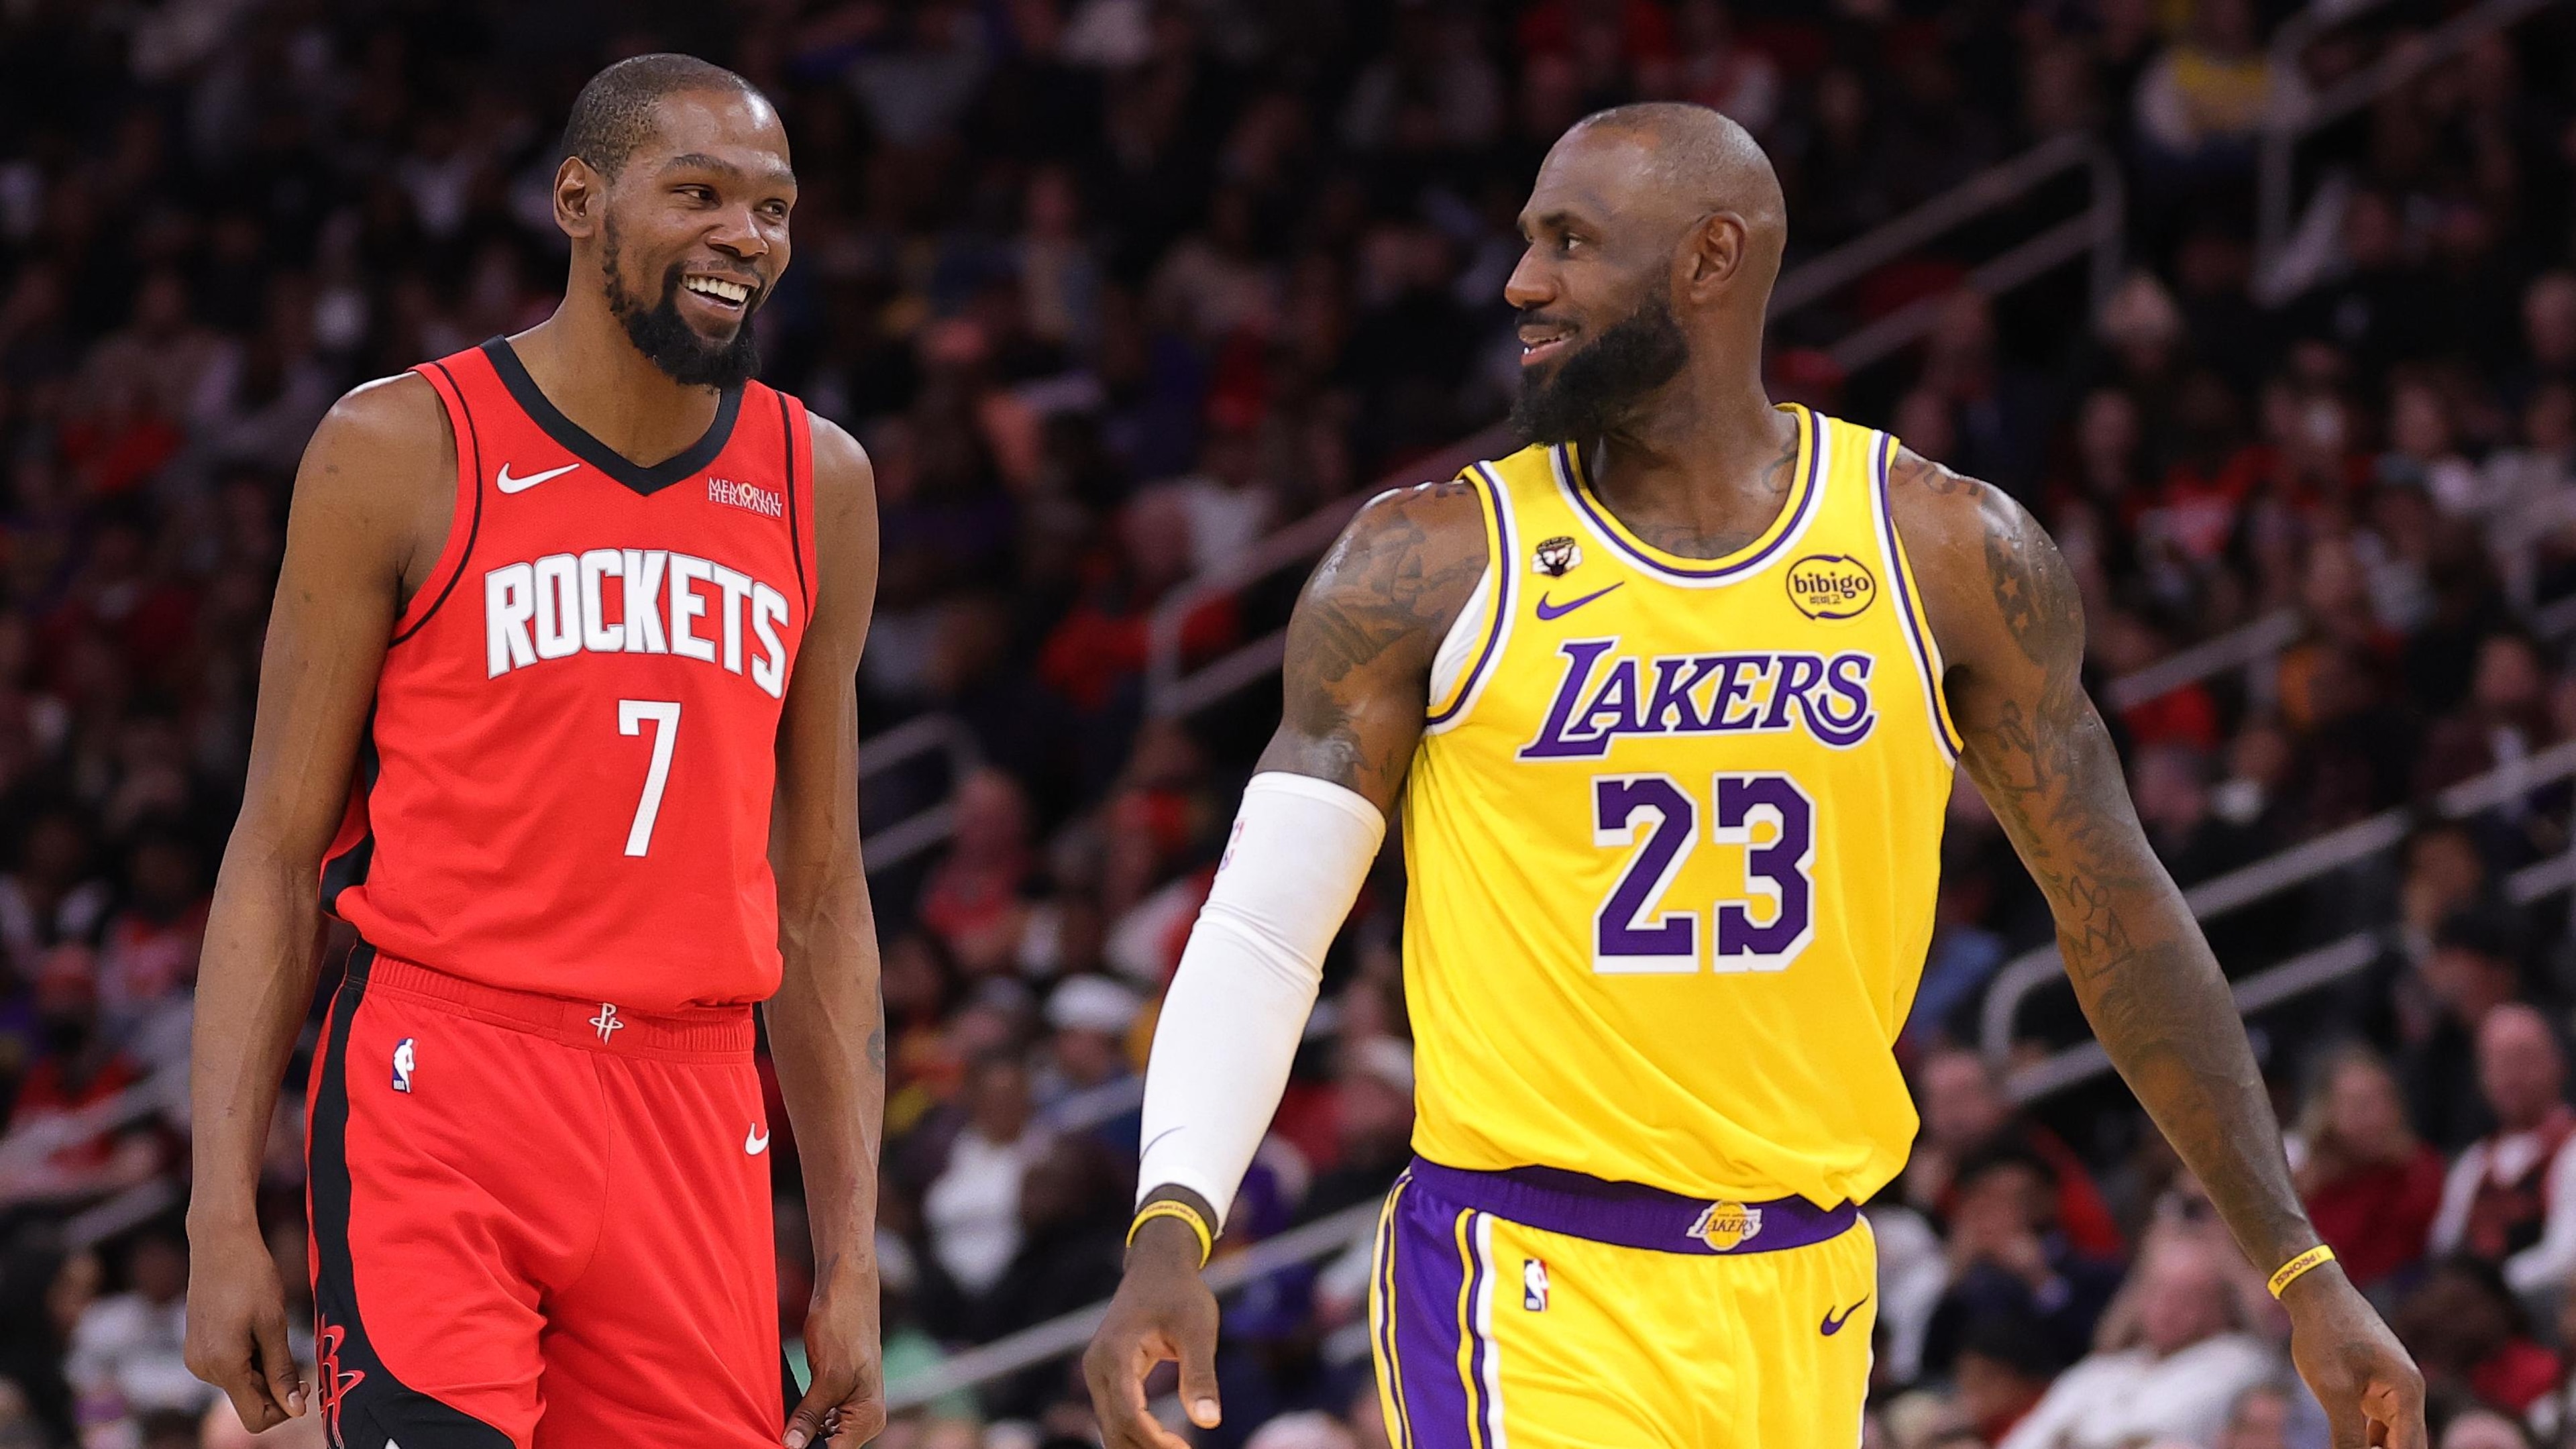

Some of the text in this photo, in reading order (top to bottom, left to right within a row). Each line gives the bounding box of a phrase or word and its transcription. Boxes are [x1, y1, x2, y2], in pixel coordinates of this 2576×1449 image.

[708, 477, 782, 506] MEMORIAL
[708, 488, 782, 517] HERMANN
[1794, 572, 1869, 598] bibigo
[485, 548, 789, 699] ROCKETS
[1515, 637, 1878, 760] LAKERS
[619, 699, 681, 857] 7
[1592, 771, 1816, 973] 23
[1694, 1211, 1757, 1237] LAKERS
